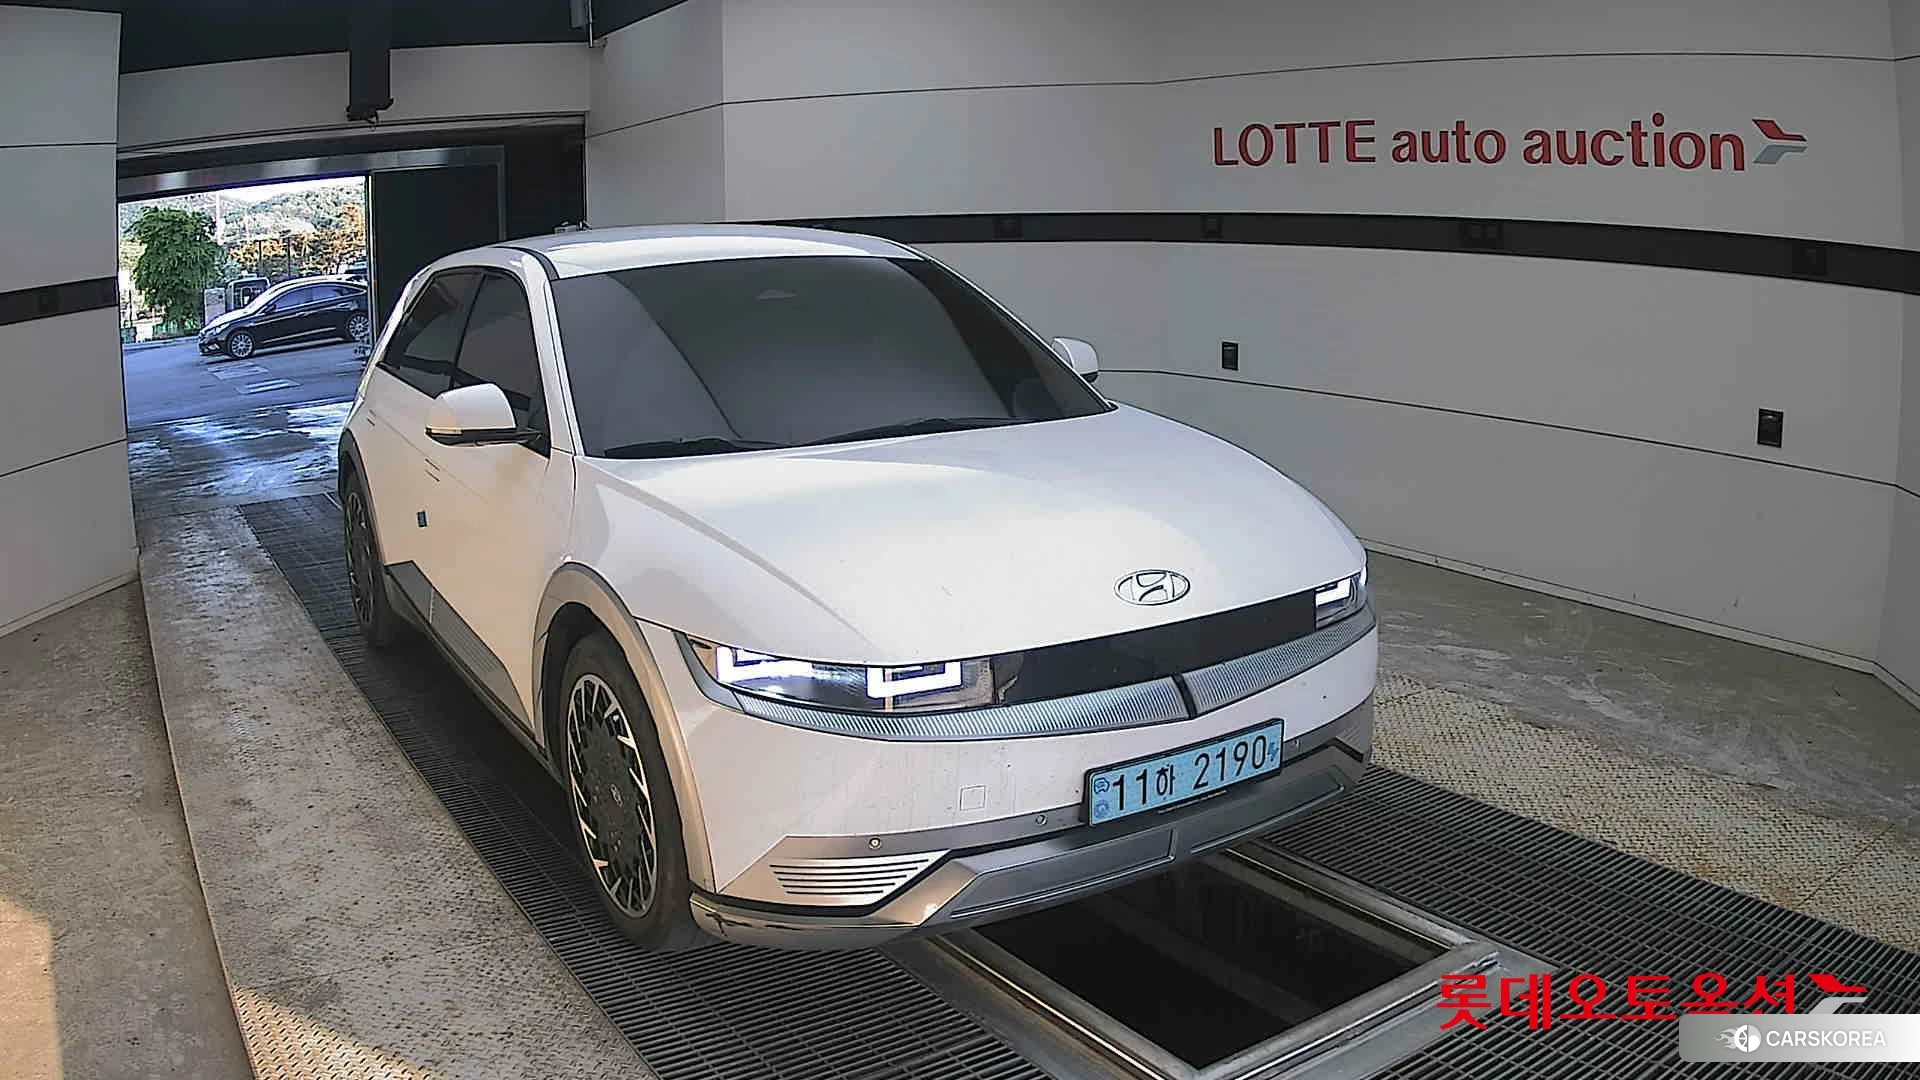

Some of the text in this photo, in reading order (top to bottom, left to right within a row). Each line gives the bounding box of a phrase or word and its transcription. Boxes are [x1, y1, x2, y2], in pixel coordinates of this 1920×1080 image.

[1213, 112, 1746, 171] LOTTE auto auction
[1113, 735, 1267, 811] 11하 2190
